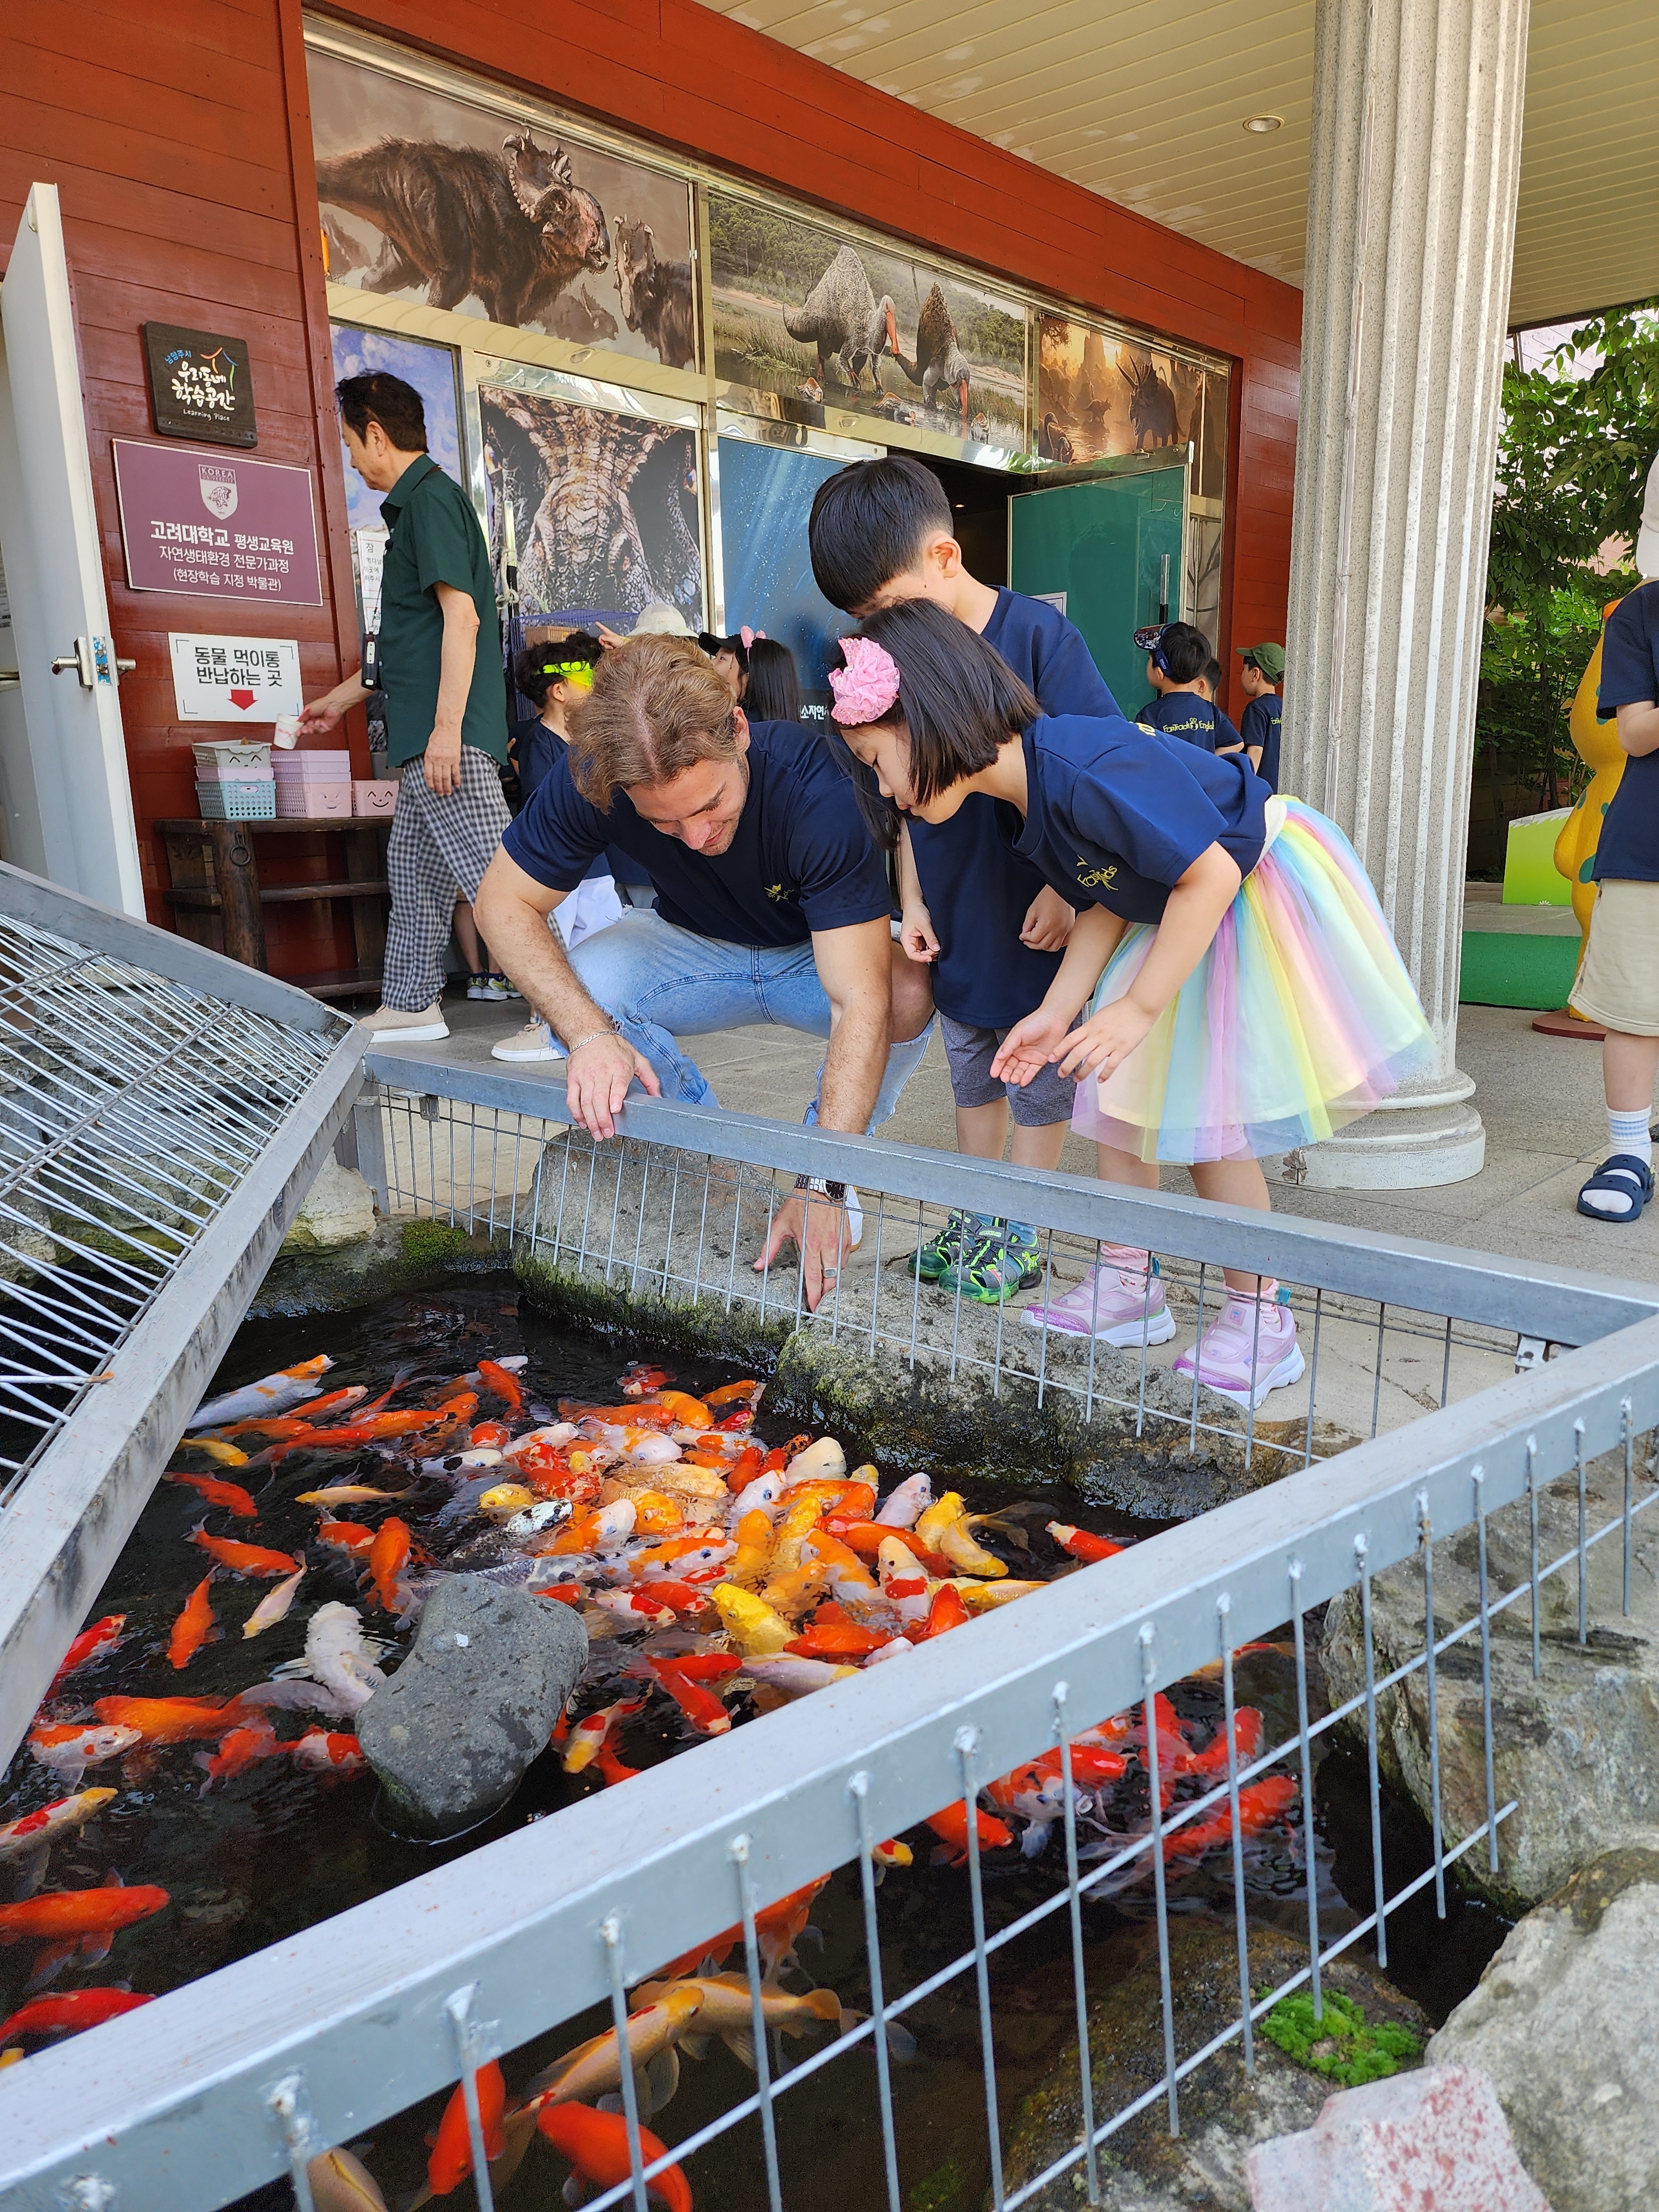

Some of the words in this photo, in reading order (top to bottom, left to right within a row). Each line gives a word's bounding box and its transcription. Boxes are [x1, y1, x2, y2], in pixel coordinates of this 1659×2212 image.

[165, 349, 192, 364] 남양주시
[178, 361, 227, 387] 우리동네
[171, 378, 236, 410] 학습공간
[183, 409, 211, 421] Learning
[201, 467, 233, 479] KOREA
[150, 520, 231, 547] 고려대학교
[234, 534, 294, 555] 평생교육원
[159, 545, 231, 567] 자연생태환경
[233, 554, 290, 573] 전문가과정
[173, 567, 221, 586] (현장학습
[223, 573, 244, 588] 지정
[247, 576, 281, 592] 박물관)
[195, 646, 227, 666] 동물
[233, 649, 280, 668] 먹이통
[196, 666, 261, 686] 반납하는
[267, 670, 283, 687] 곳
